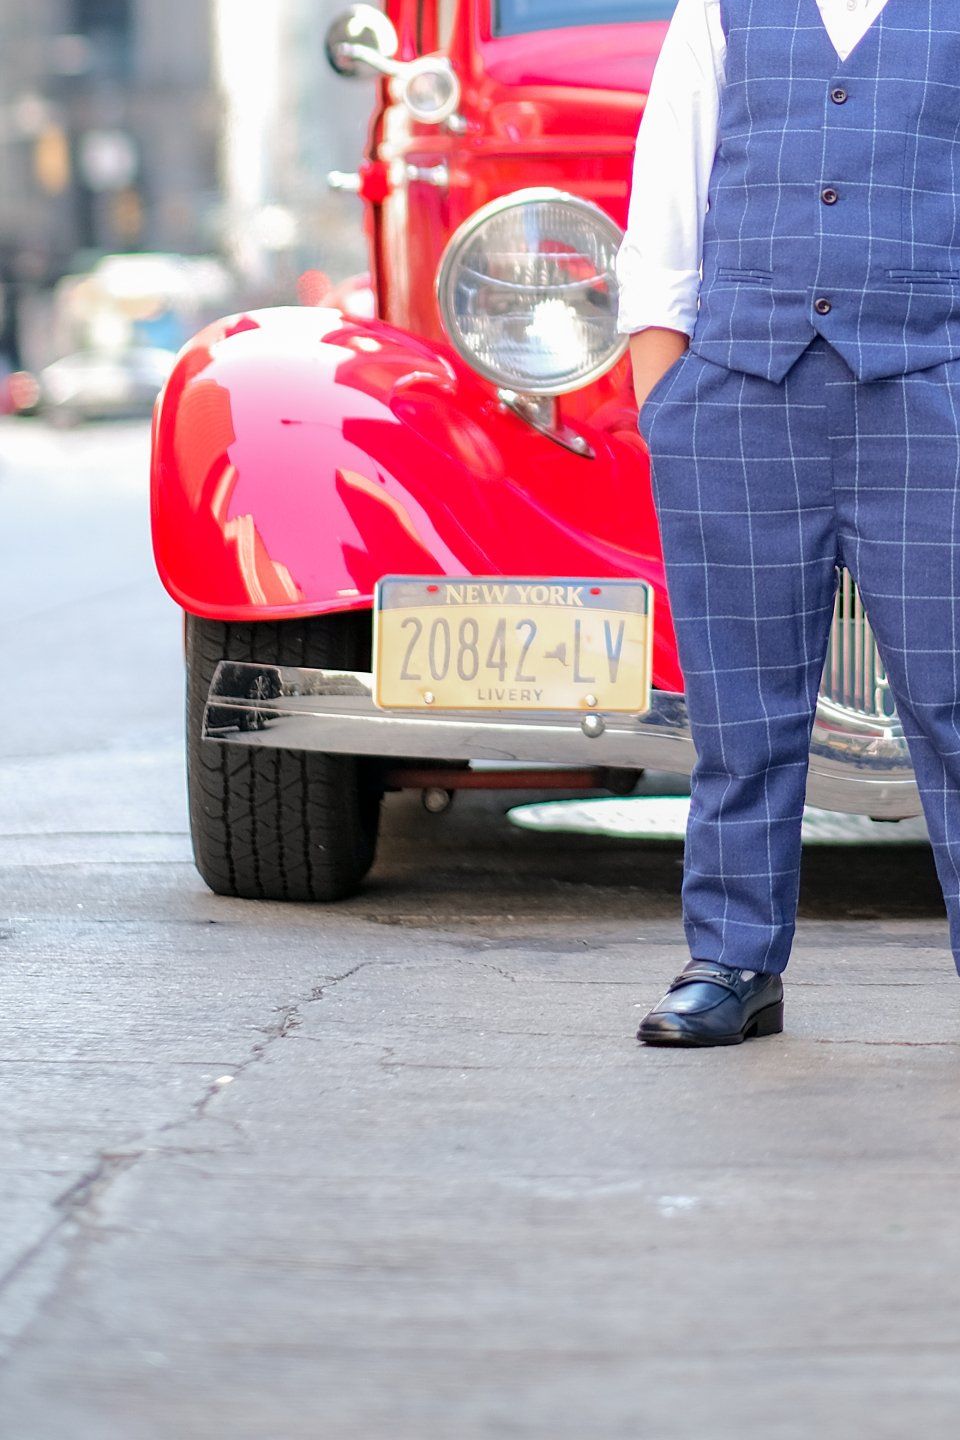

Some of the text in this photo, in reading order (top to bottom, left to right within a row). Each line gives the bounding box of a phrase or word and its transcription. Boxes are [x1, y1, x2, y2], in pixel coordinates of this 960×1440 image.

[445, 584, 584, 606] NEW YORK
[400, 616, 537, 682] 20842
[477, 688, 544, 702] LIVERY
